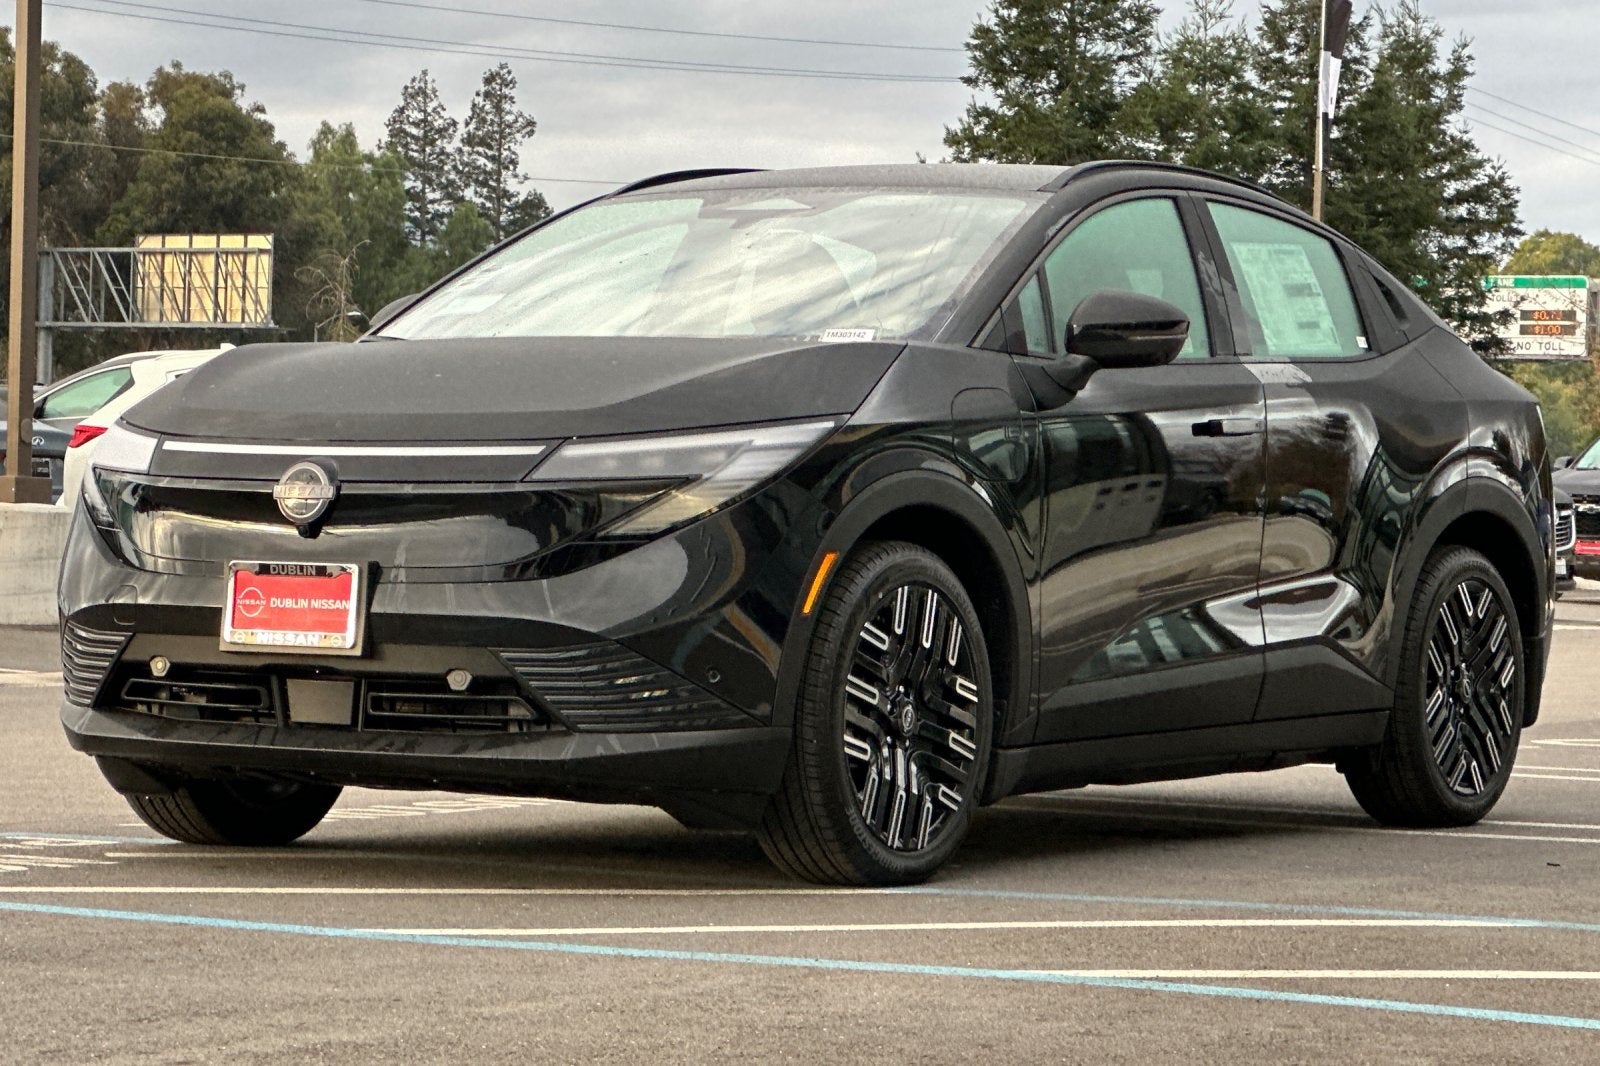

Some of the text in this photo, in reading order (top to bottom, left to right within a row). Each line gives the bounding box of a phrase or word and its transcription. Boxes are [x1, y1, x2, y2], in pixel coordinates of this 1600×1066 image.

[1533, 325, 1561, 334] $1.00
[1516, 341, 1565, 351] NO TOLL
[270, 564, 316, 576] DUBLIN
[237, 598, 266, 606] NISSAN
[270, 597, 350, 610] DUBLIN NISSAN
[256, 632, 317, 645] NISSAN
